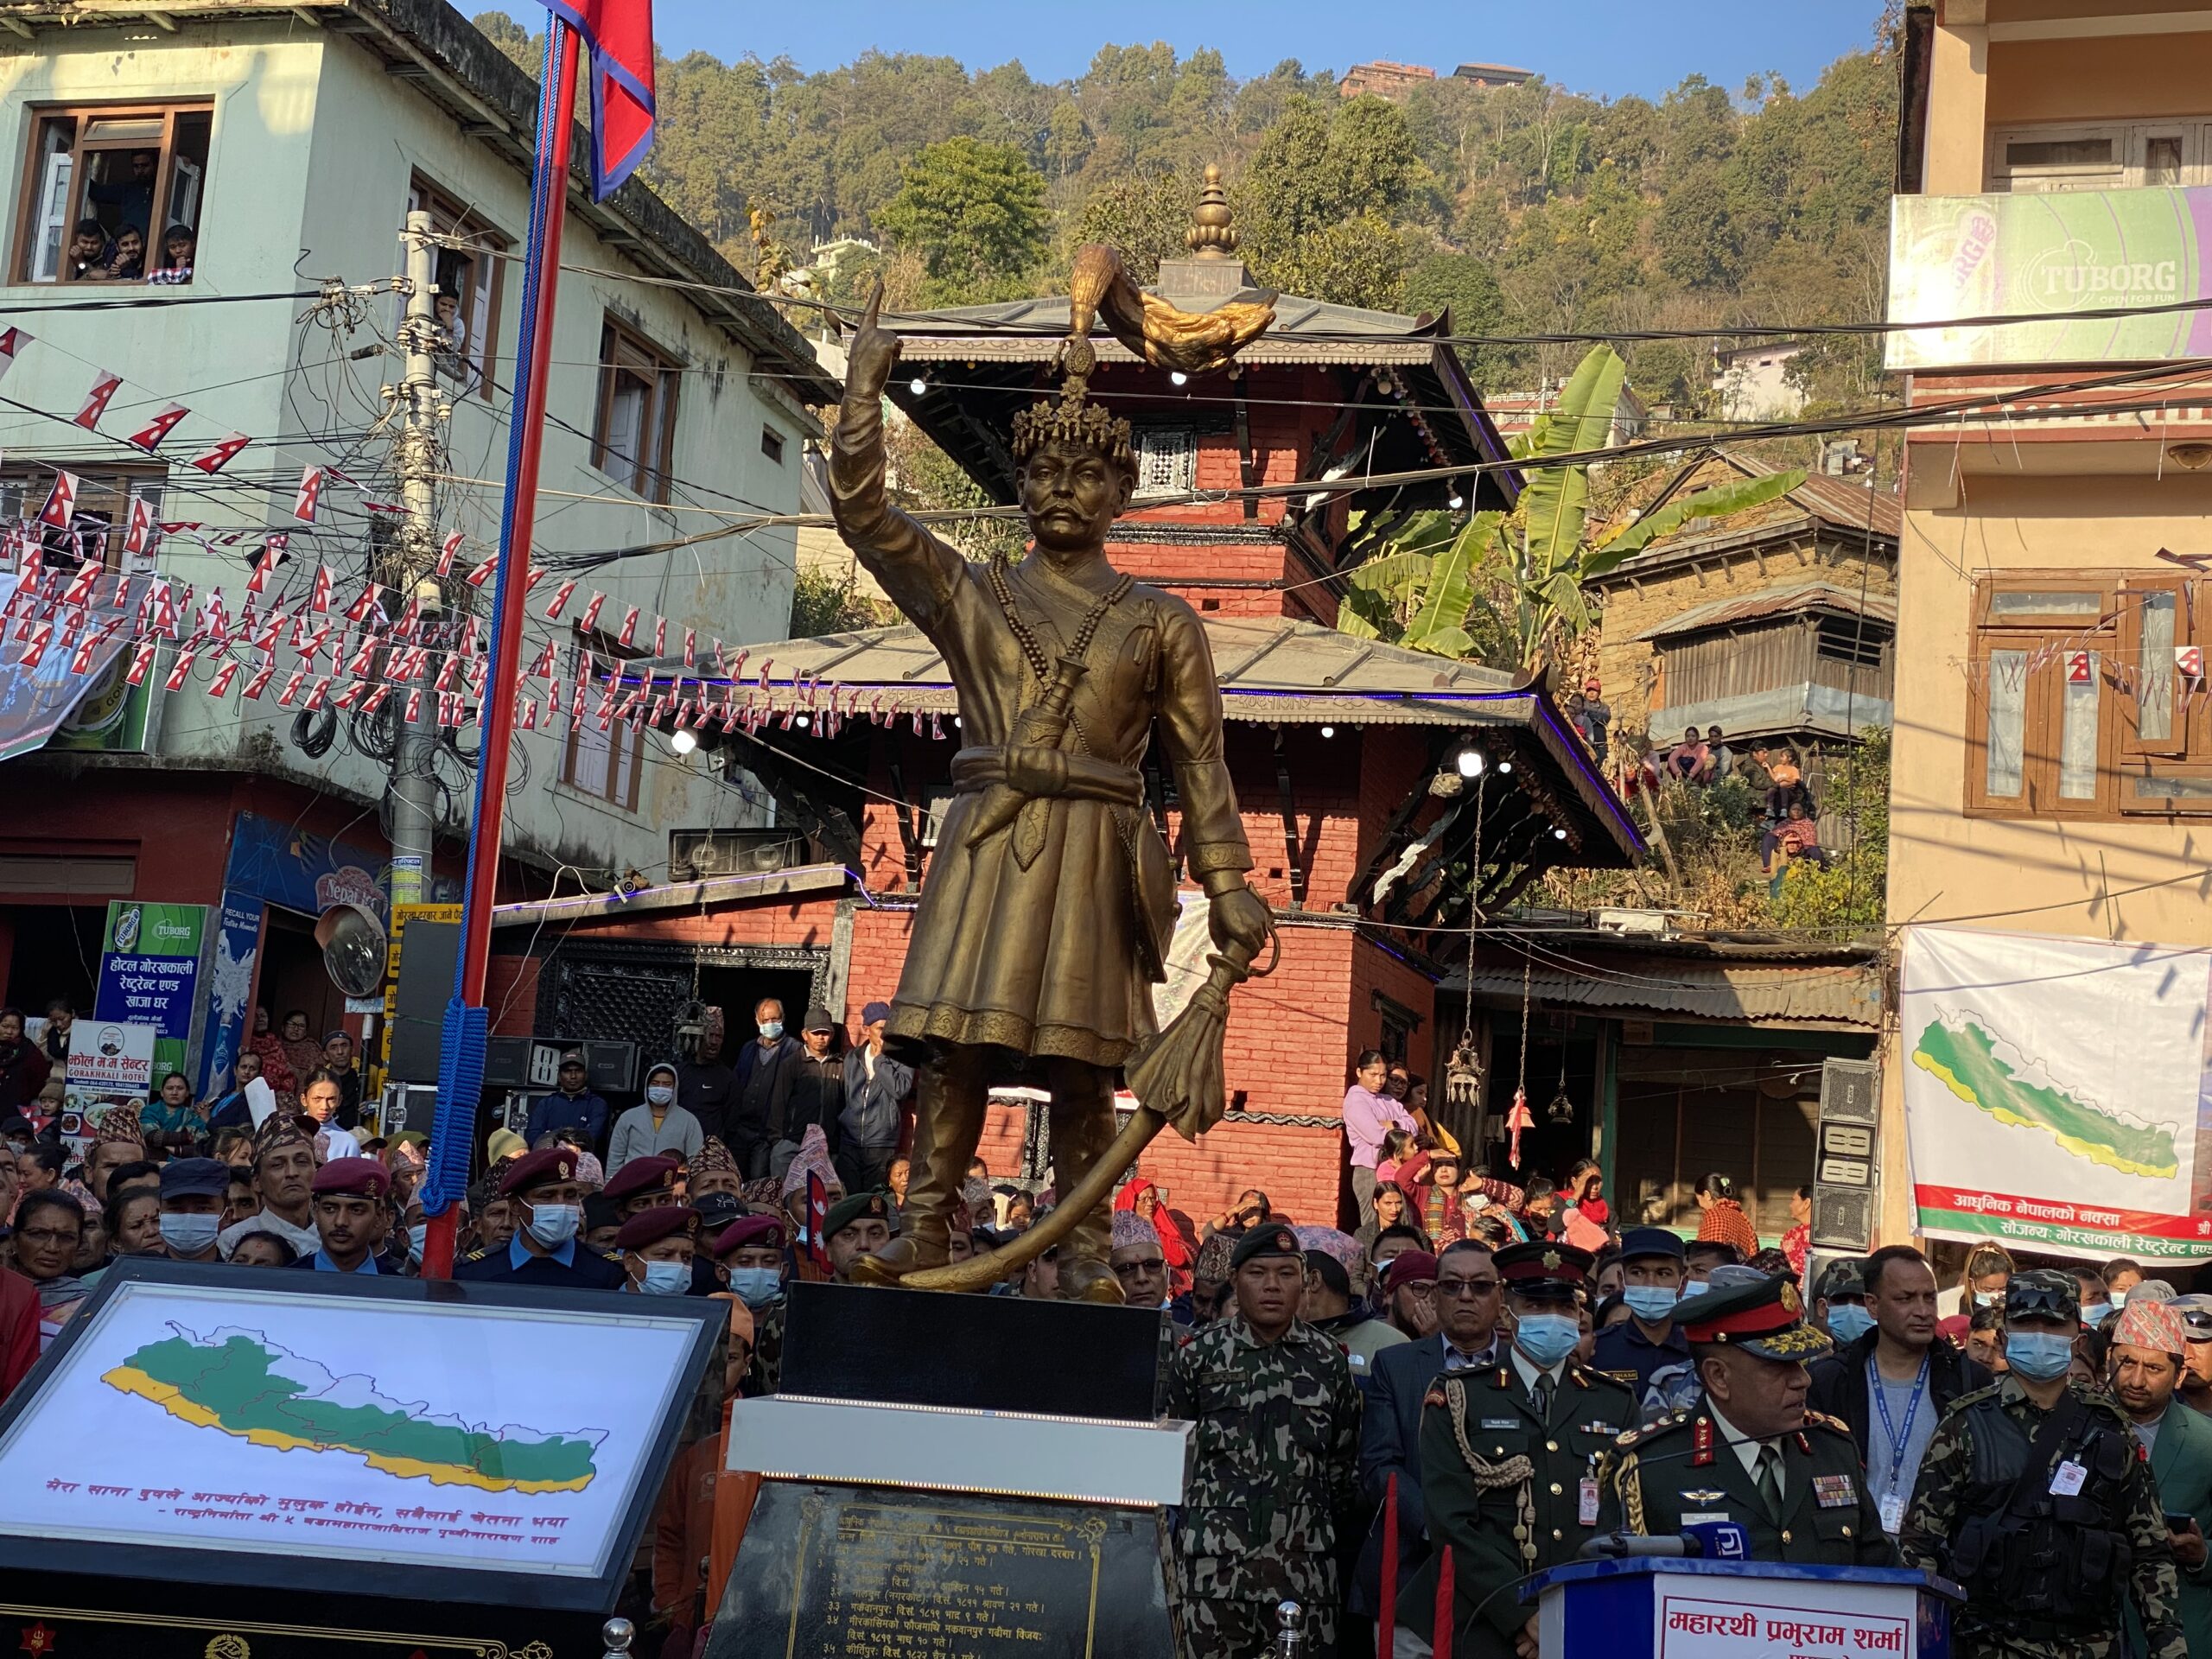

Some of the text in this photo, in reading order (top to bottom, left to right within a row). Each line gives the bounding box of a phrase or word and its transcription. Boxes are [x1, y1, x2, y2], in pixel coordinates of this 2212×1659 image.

[2040, 260, 2176, 296] TUBORG
[2100, 292, 2176, 304] OPEN FOR FUN
[325, 878, 357, 904] Nepal
[225, 908, 260, 922] RECALL YOUR
[439, 908, 452, 920] जाने
[117, 917, 137, 944] TUBORG
[158, 925, 190, 936] TUBORG
[110, 957, 194, 975] होटल गोरखकाली
[158, 980, 180, 991] एण्ड
[125, 995, 168, 1009] खाजा घर
[120, 1055, 149, 1071] सेन्टर
[68, 1069, 146, 1082] GORAKHKALI HOTEL
[1953, 1193, 2121, 1227] आधुनिक नेपालको नक्सा
[2056, 1226, 2131, 1250] गोरखकाली
[46, 1478, 80, 1493] मेरा
[88, 1484, 132, 1497] साना
[470, 1511, 524, 1527] चेतना
[532, 1516, 569, 1529] भया
[258, 1512, 280, 1523] श्री
[1022, 1545, 1046, 1557] गोरखा
[1669, 1612, 1903, 1651] महारथी प्रभुराम शर्मा
